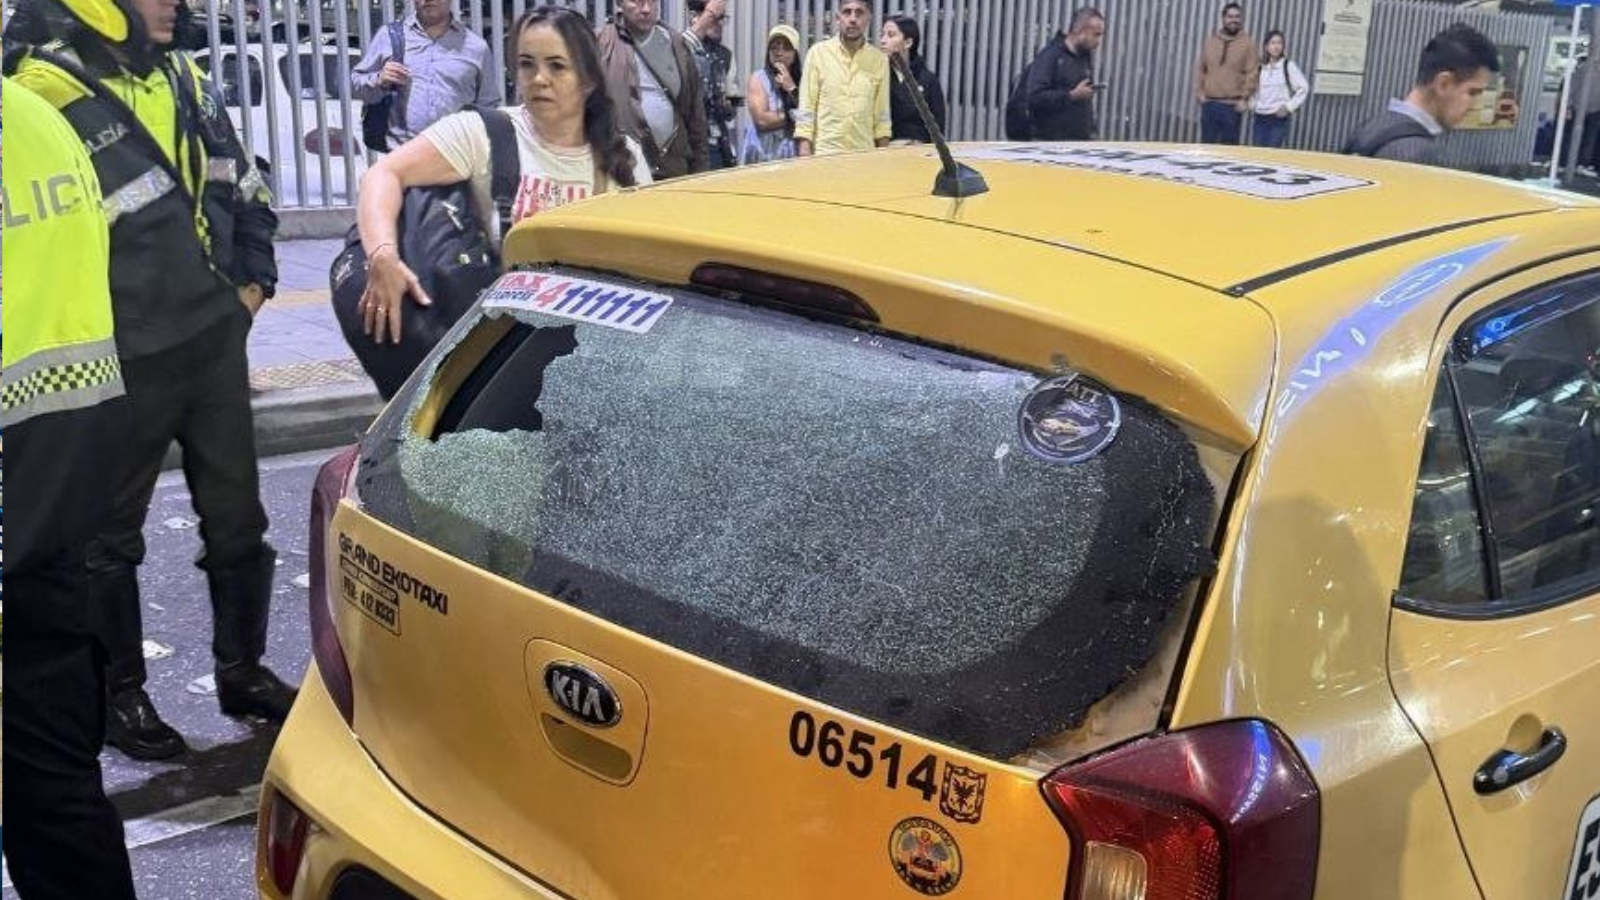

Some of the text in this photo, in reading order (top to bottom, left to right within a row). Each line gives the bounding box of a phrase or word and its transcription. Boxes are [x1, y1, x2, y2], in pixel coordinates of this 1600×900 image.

[338, 532, 380, 575] GRAND
[382, 560, 448, 616] EKOTAXI
[552, 669, 606, 722] KIA
[789, 710, 938, 802] 06514
